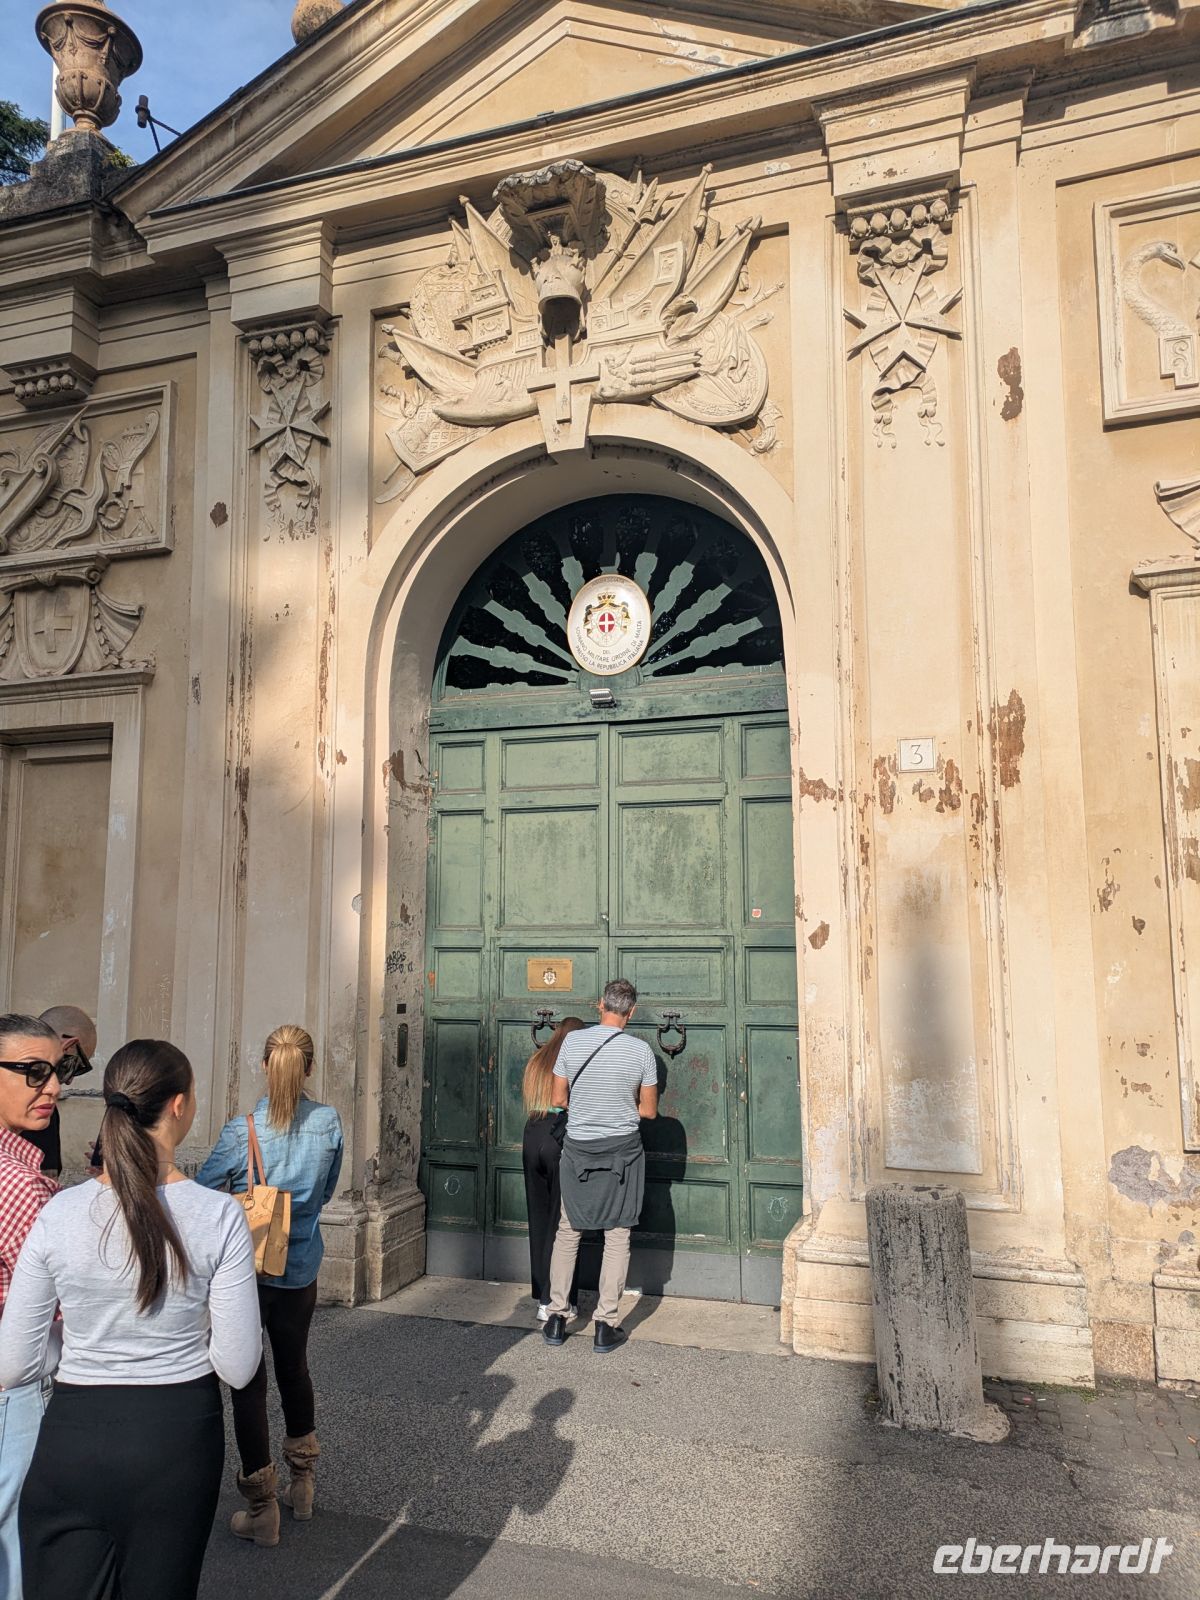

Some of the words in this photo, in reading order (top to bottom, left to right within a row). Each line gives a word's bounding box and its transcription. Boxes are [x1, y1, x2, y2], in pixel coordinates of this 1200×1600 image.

[575, 645, 589, 662] PRESSO
[596, 659, 628, 671] REPUBBLICA
[627, 639, 645, 661] ITALIANA
[587, 649, 610, 663] MILITARE
[611, 648, 632, 662] ORDINE
[635, 620, 643, 639] MALTA
[910, 744, 923, 765] 3
